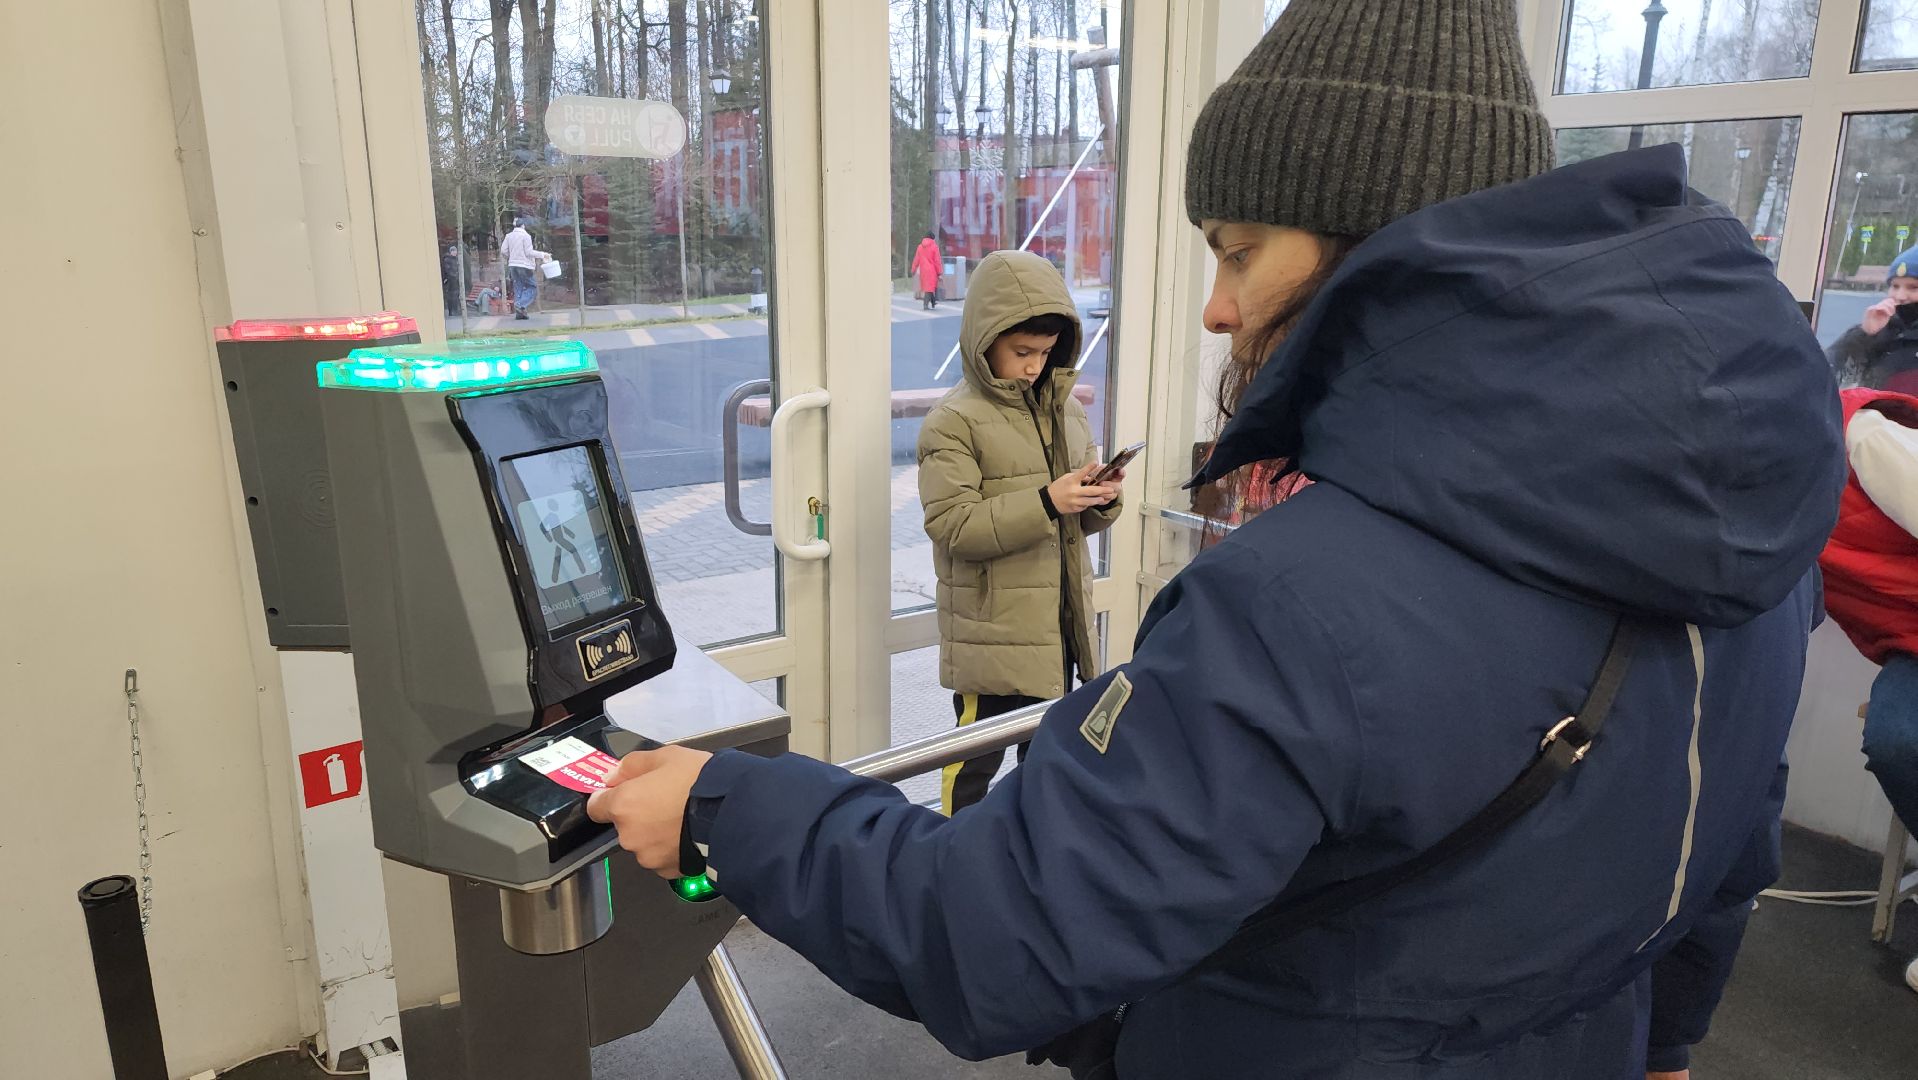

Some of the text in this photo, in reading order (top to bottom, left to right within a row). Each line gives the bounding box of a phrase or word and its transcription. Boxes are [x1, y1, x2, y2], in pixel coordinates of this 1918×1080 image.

[541, 585, 613, 616] Выход разрешен
[560, 766, 596, 785] КАТОК
